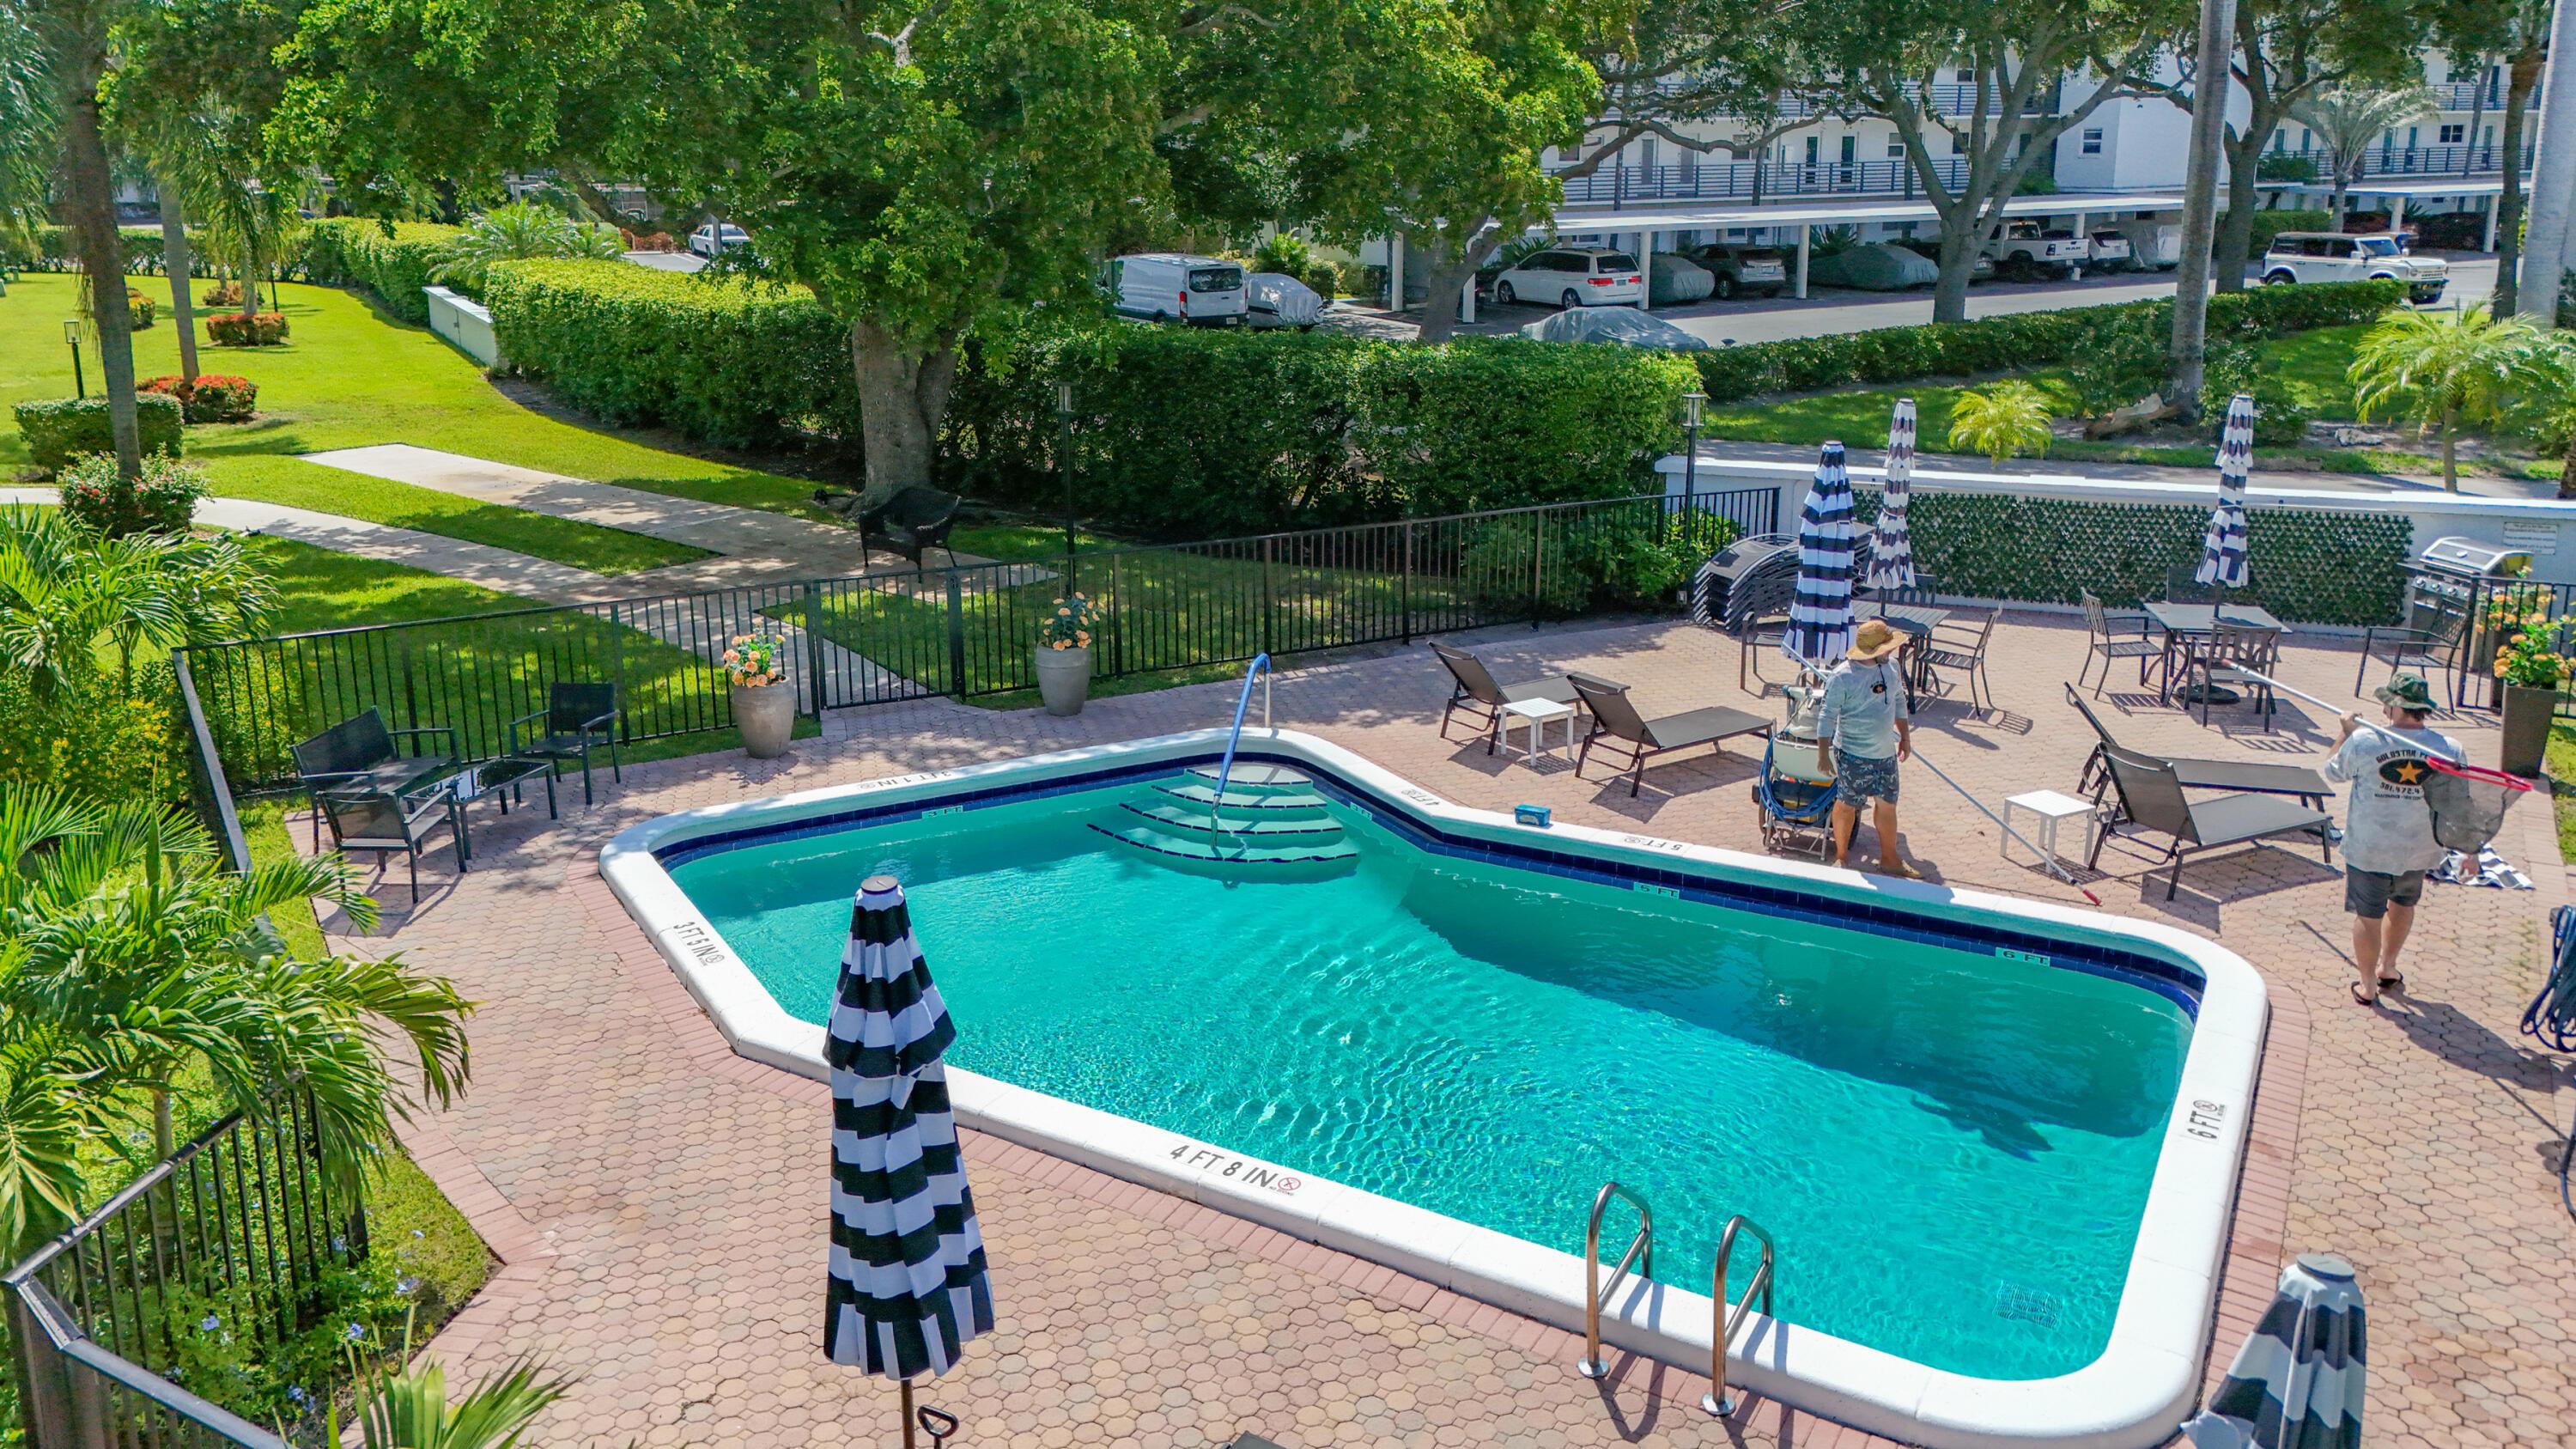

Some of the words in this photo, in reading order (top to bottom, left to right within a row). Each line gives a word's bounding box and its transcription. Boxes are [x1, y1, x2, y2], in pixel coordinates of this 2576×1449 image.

[2375, 749, 2416, 764] GOLDSTAR
[877, 778, 899, 787] IN
[1643, 839, 1667, 849] FT
[1657, 887, 1678, 897] FT
[677, 927, 705, 940] FT
[691, 944, 720, 958] IN
[2002, 950, 2015, 959] 6
[2024, 953, 2048, 964] FT
[2189, 1110, 2221, 1130] FT
[2187, 1128, 2218, 1139] 6
[1170, 1145, 1190, 1160] 4
[1188, 1150, 1224, 1169] FT
[1222, 1161, 1243, 1177] 8
[1242, 1166, 1279, 1188] IN
